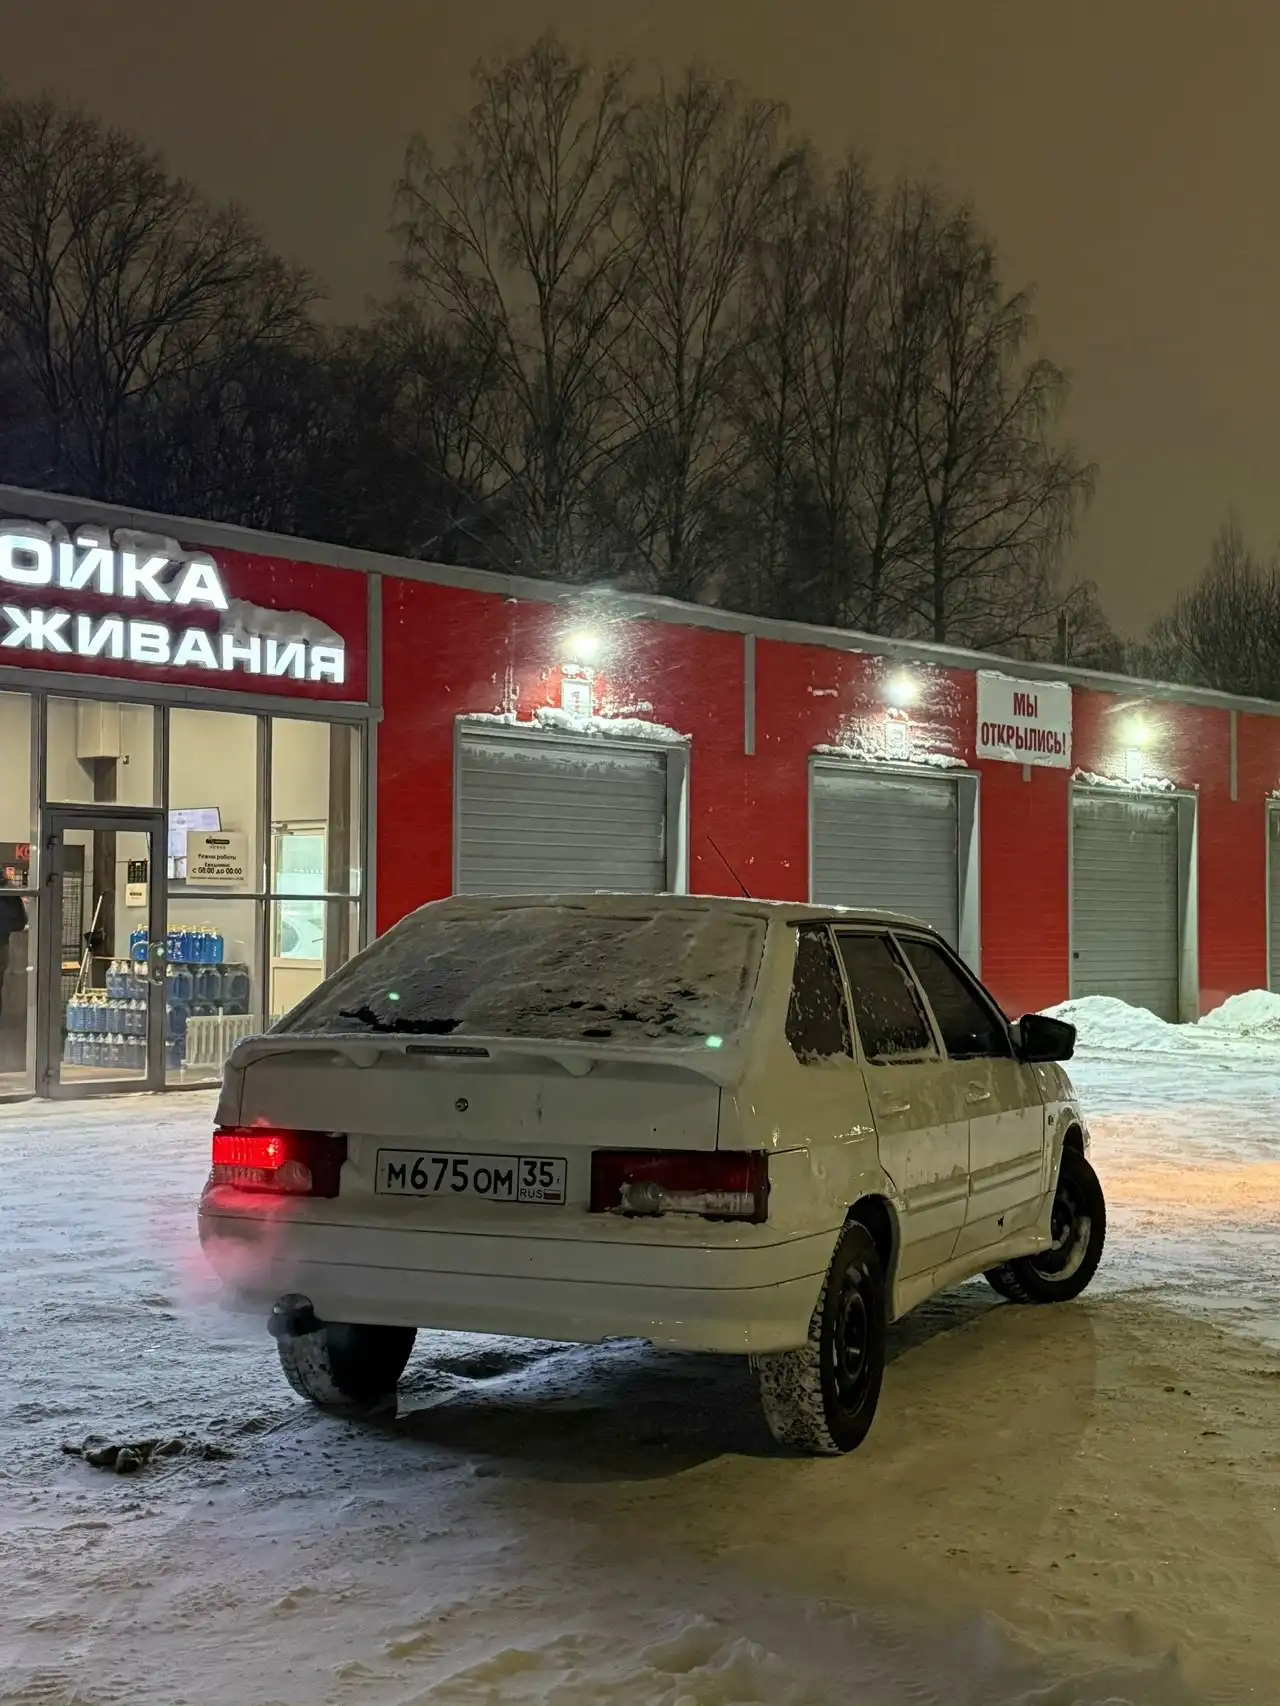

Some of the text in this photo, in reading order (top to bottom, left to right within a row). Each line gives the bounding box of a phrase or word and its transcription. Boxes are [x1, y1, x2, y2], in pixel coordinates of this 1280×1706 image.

[0, 534, 229, 610] ОЙКА
[1, 606, 345, 684] ЖИВАНИЯ
[1013, 692, 1038, 718] МЫ
[981, 722, 1066, 755] ОТКРЫЛИСЬ!
[523, 1161, 554, 1187] 35
[519, 1188, 543, 1199] RUS
